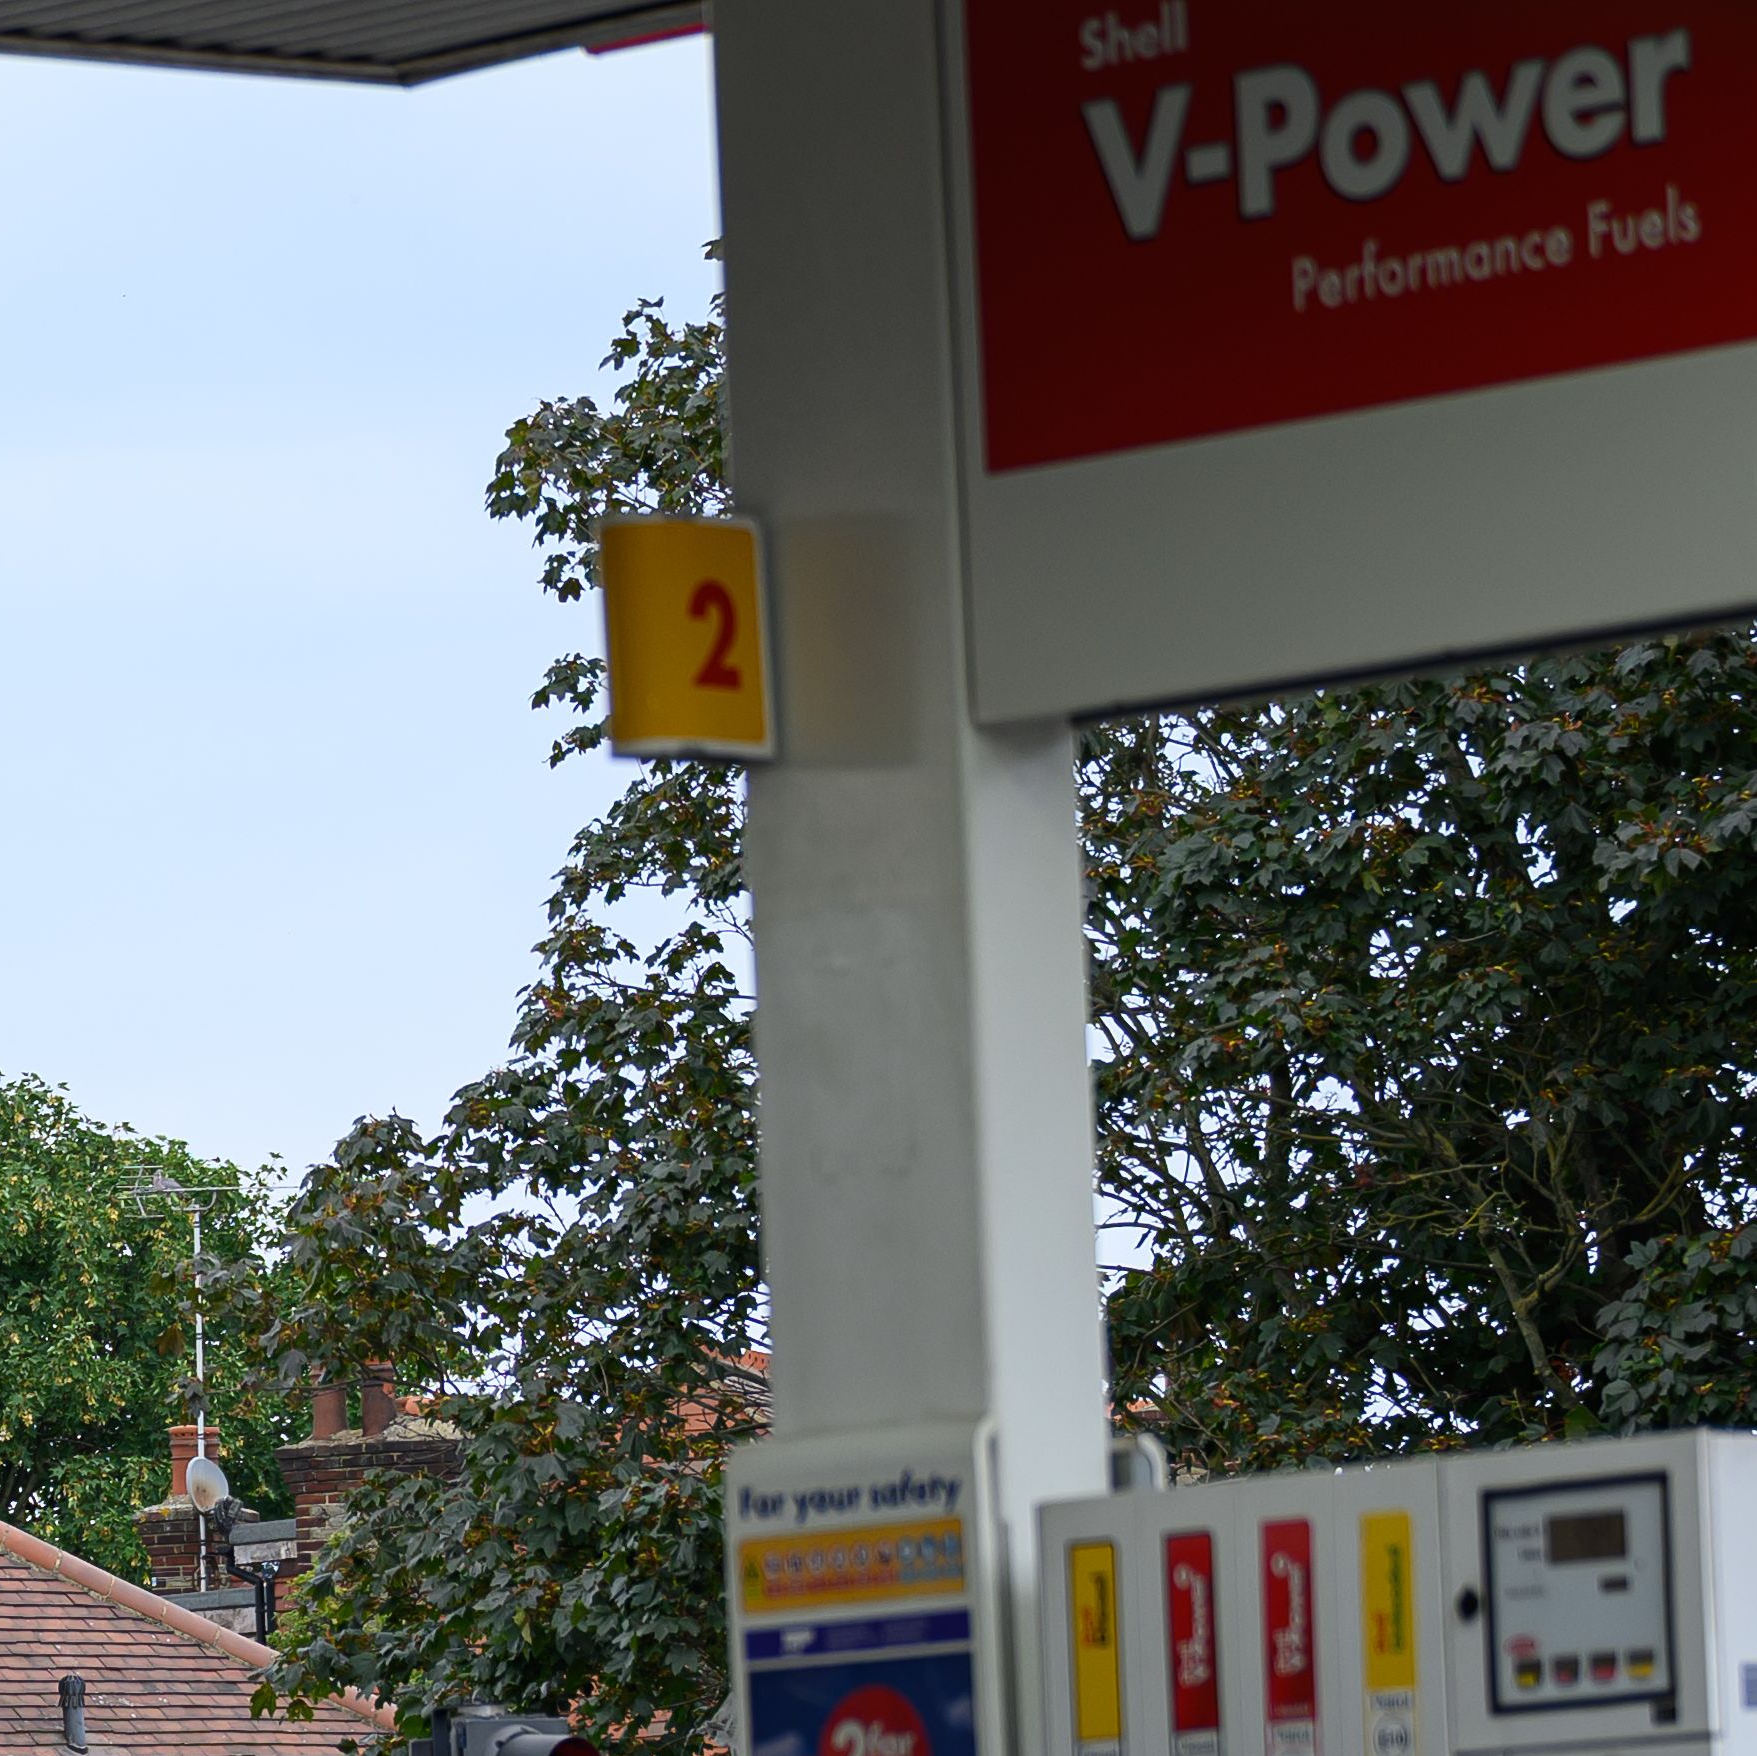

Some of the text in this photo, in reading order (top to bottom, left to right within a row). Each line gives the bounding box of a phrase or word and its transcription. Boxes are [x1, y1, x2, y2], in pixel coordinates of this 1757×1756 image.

[1081, 0, 1188, 71] Shell
[1082, 27, 1691, 241] V-Power
[1291, 183, 1701, 313] Performance Fuels
[689, 577, 742, 690] 2
[792, 1487, 862, 1523] your
